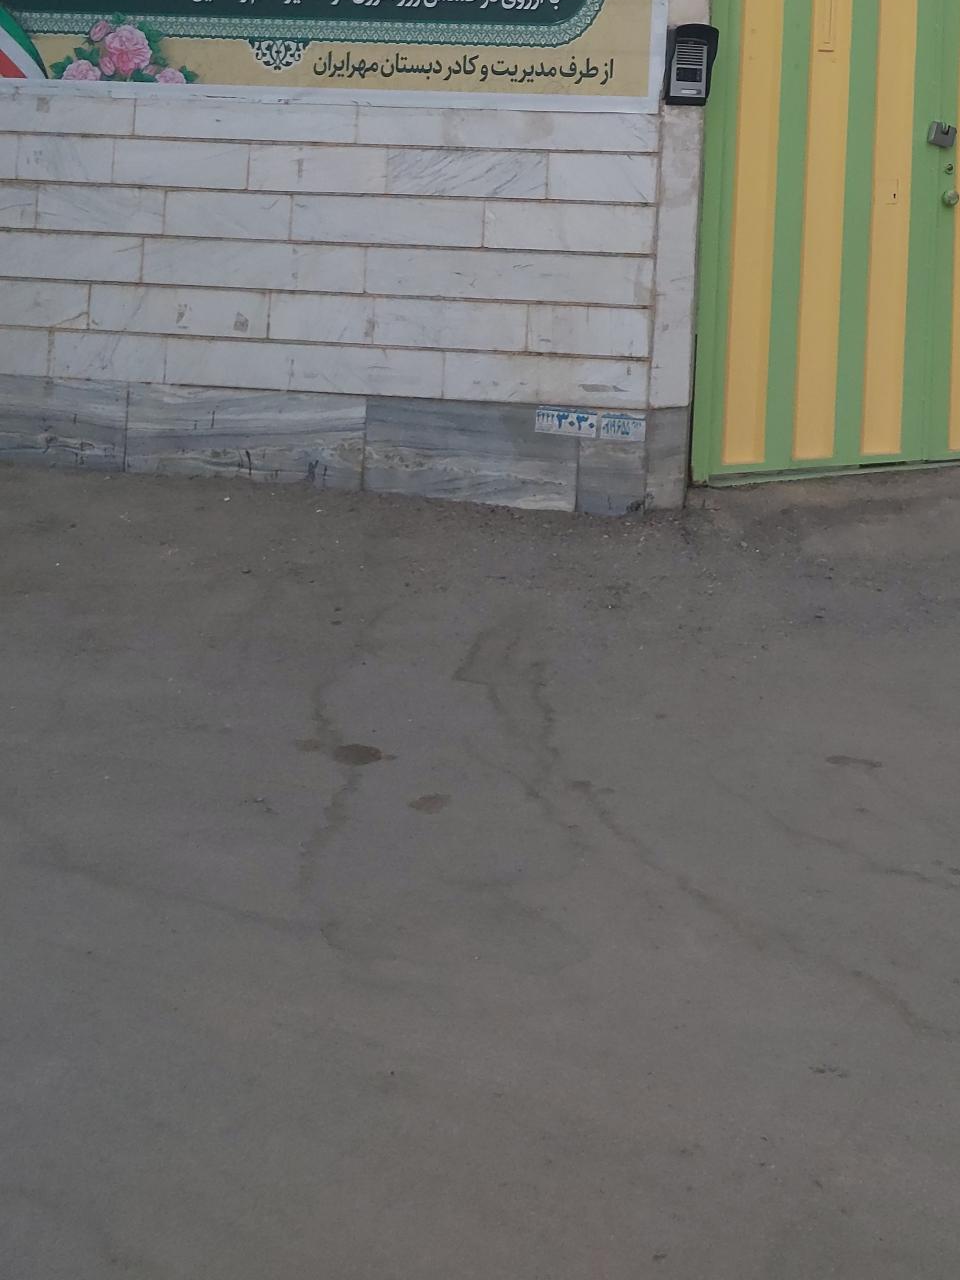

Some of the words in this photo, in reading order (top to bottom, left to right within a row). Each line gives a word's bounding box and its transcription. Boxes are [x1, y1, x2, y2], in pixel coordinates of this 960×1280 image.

[381, 53, 443, 80] دبستان
[447, 54, 479, 81] کادر
[479, 65, 488, 82] و
[494, 57, 556, 84] مدیریت
[559, 55, 599, 84] طرف
[601, 58, 614, 85] از
